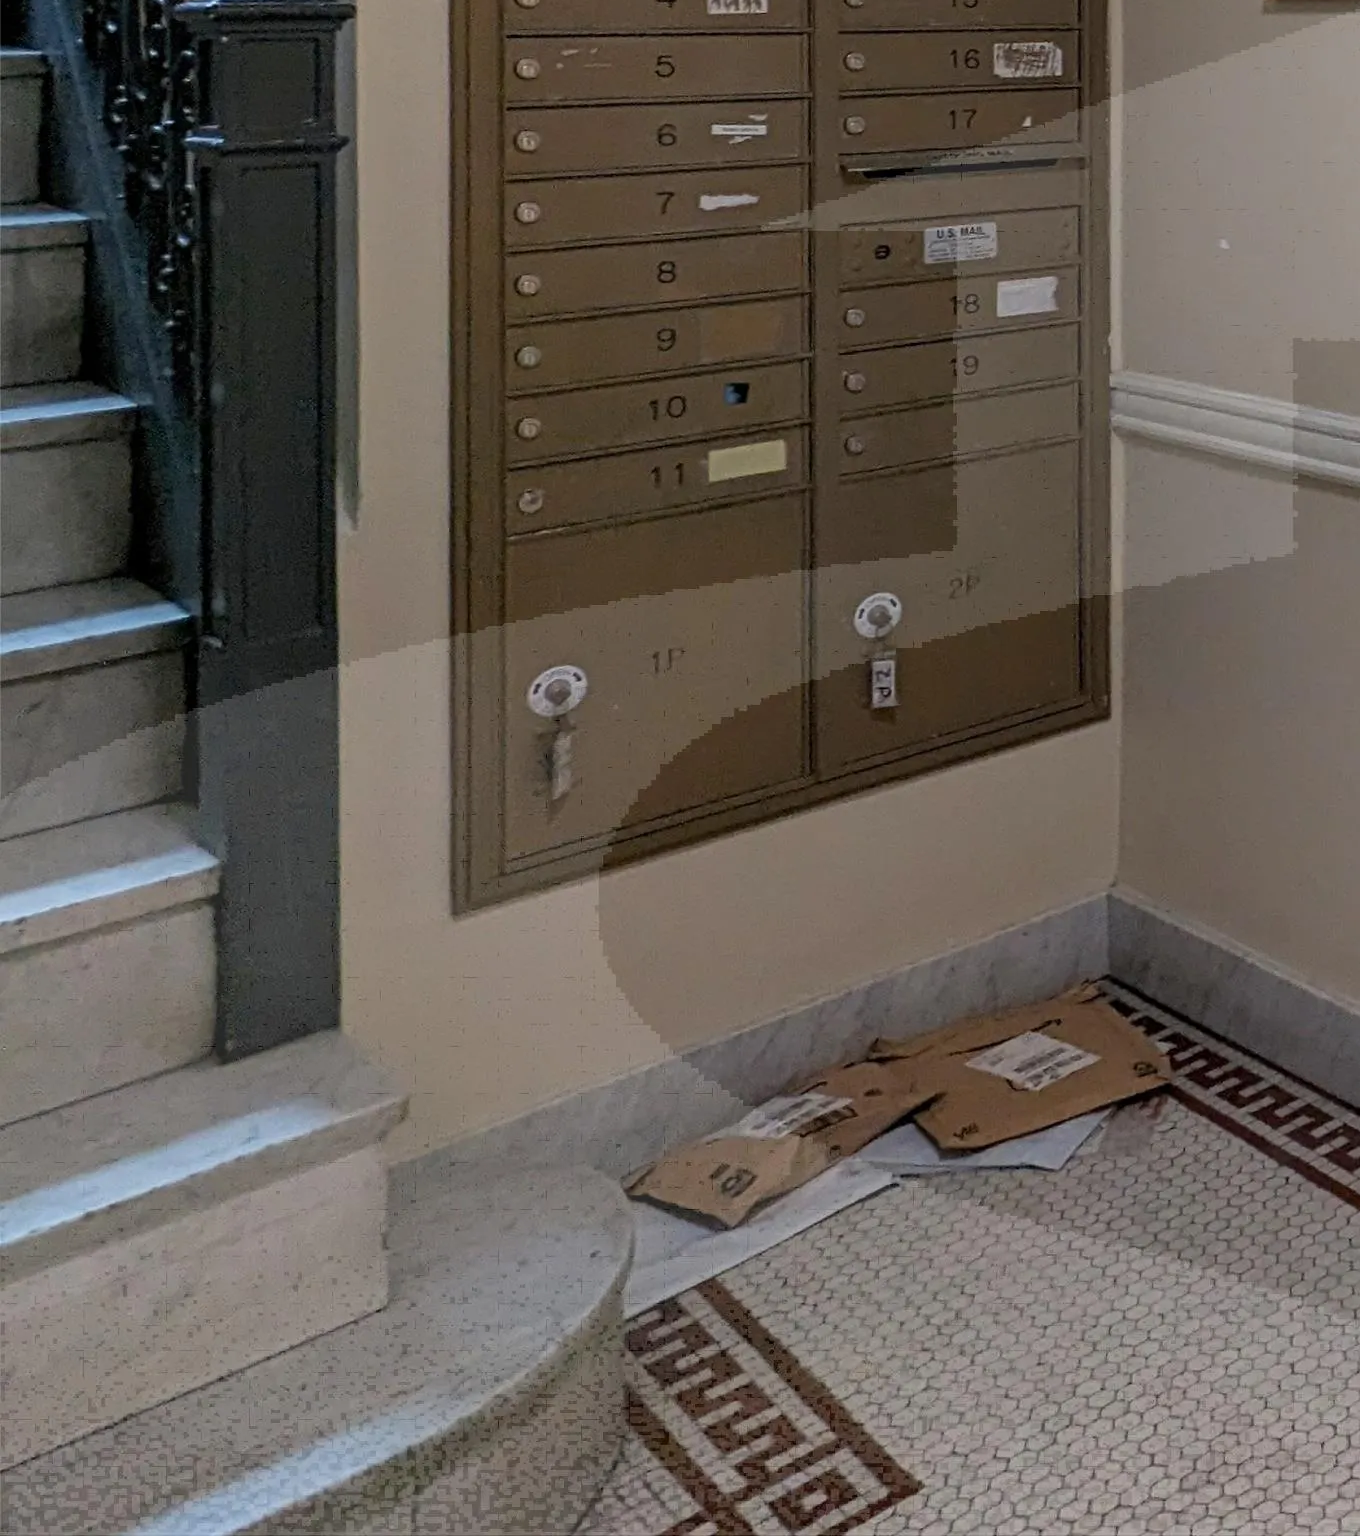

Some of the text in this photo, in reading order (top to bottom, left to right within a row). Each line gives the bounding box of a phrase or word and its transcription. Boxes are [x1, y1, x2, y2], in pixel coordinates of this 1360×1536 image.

[655, 55, 675, 79] 5
[950, 48, 980, 70] 16
[949, 109, 977, 130] 17
[656, 123, 677, 147] 6
[656, 191, 675, 214] 7
[656, 261, 677, 284] 8
[656, 328, 677, 351] 9
[649, 395, 687, 420] 10
[650, 462, 685, 488] 11
